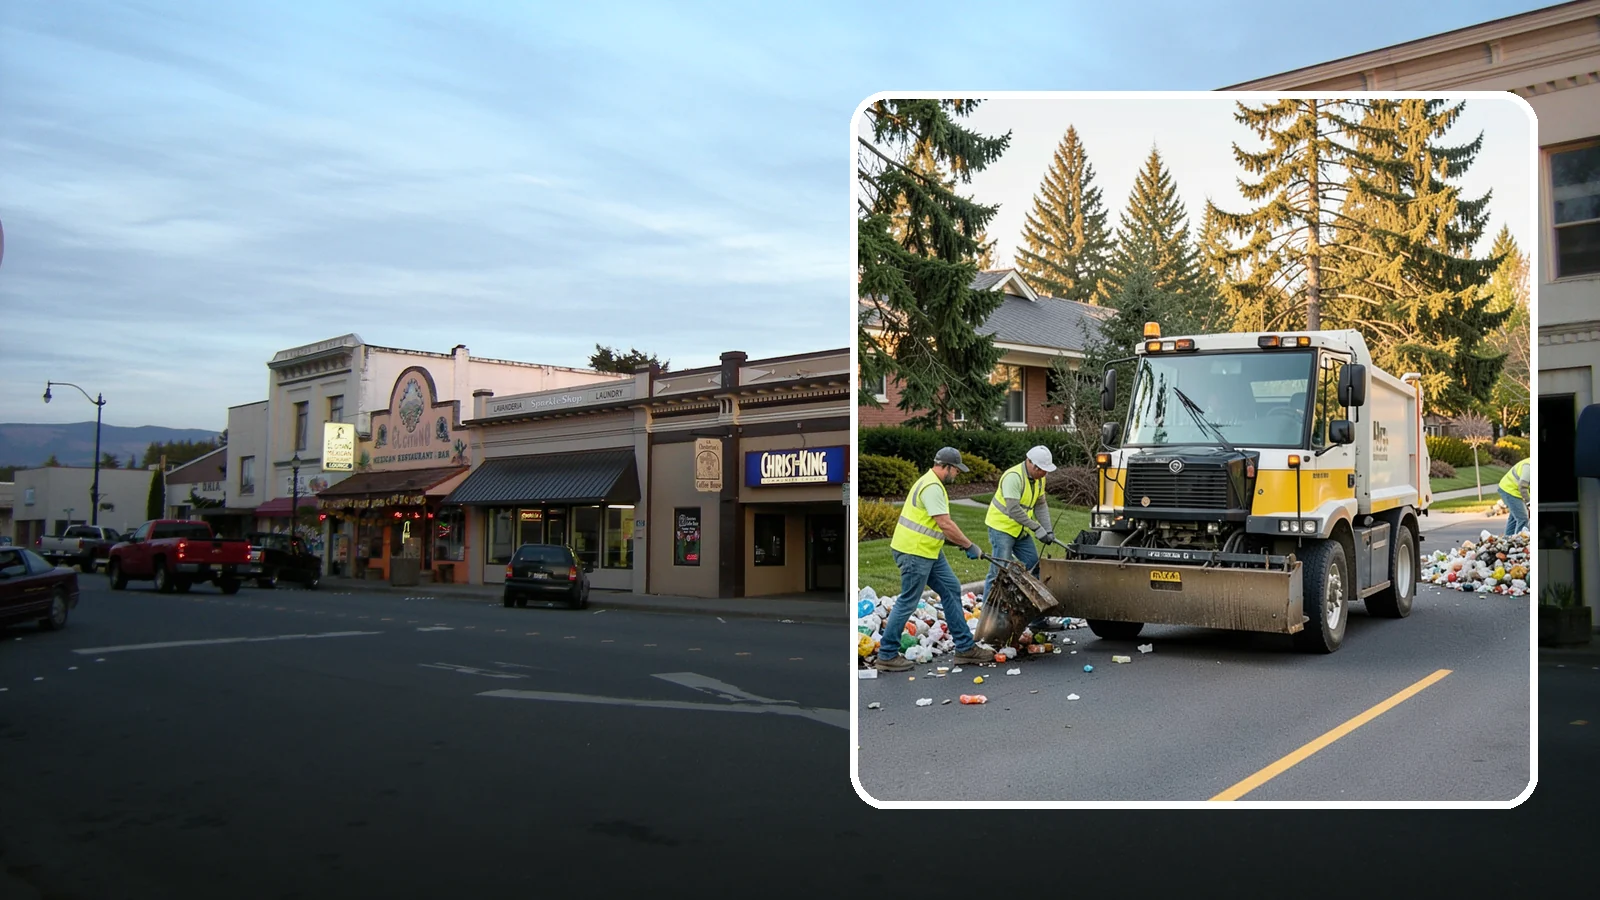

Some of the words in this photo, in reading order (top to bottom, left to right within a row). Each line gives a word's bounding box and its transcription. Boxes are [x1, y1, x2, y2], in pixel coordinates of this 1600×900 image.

[595, 389, 623, 400] LAUNDRY
[493, 402, 522, 413] LAVANDERIA
[531, 398, 560, 409] Sparkle
[561, 394, 583, 404] Shop
[373, 455, 396, 464] MEXICAN
[397, 451, 434, 463] RESTAURANT
[438, 450, 450, 460] BAR
[761, 451, 797, 478] CHRIST
[799, 449, 827, 477] KING
[697, 480, 709, 489] Coffee
[710, 480, 722, 489] House
